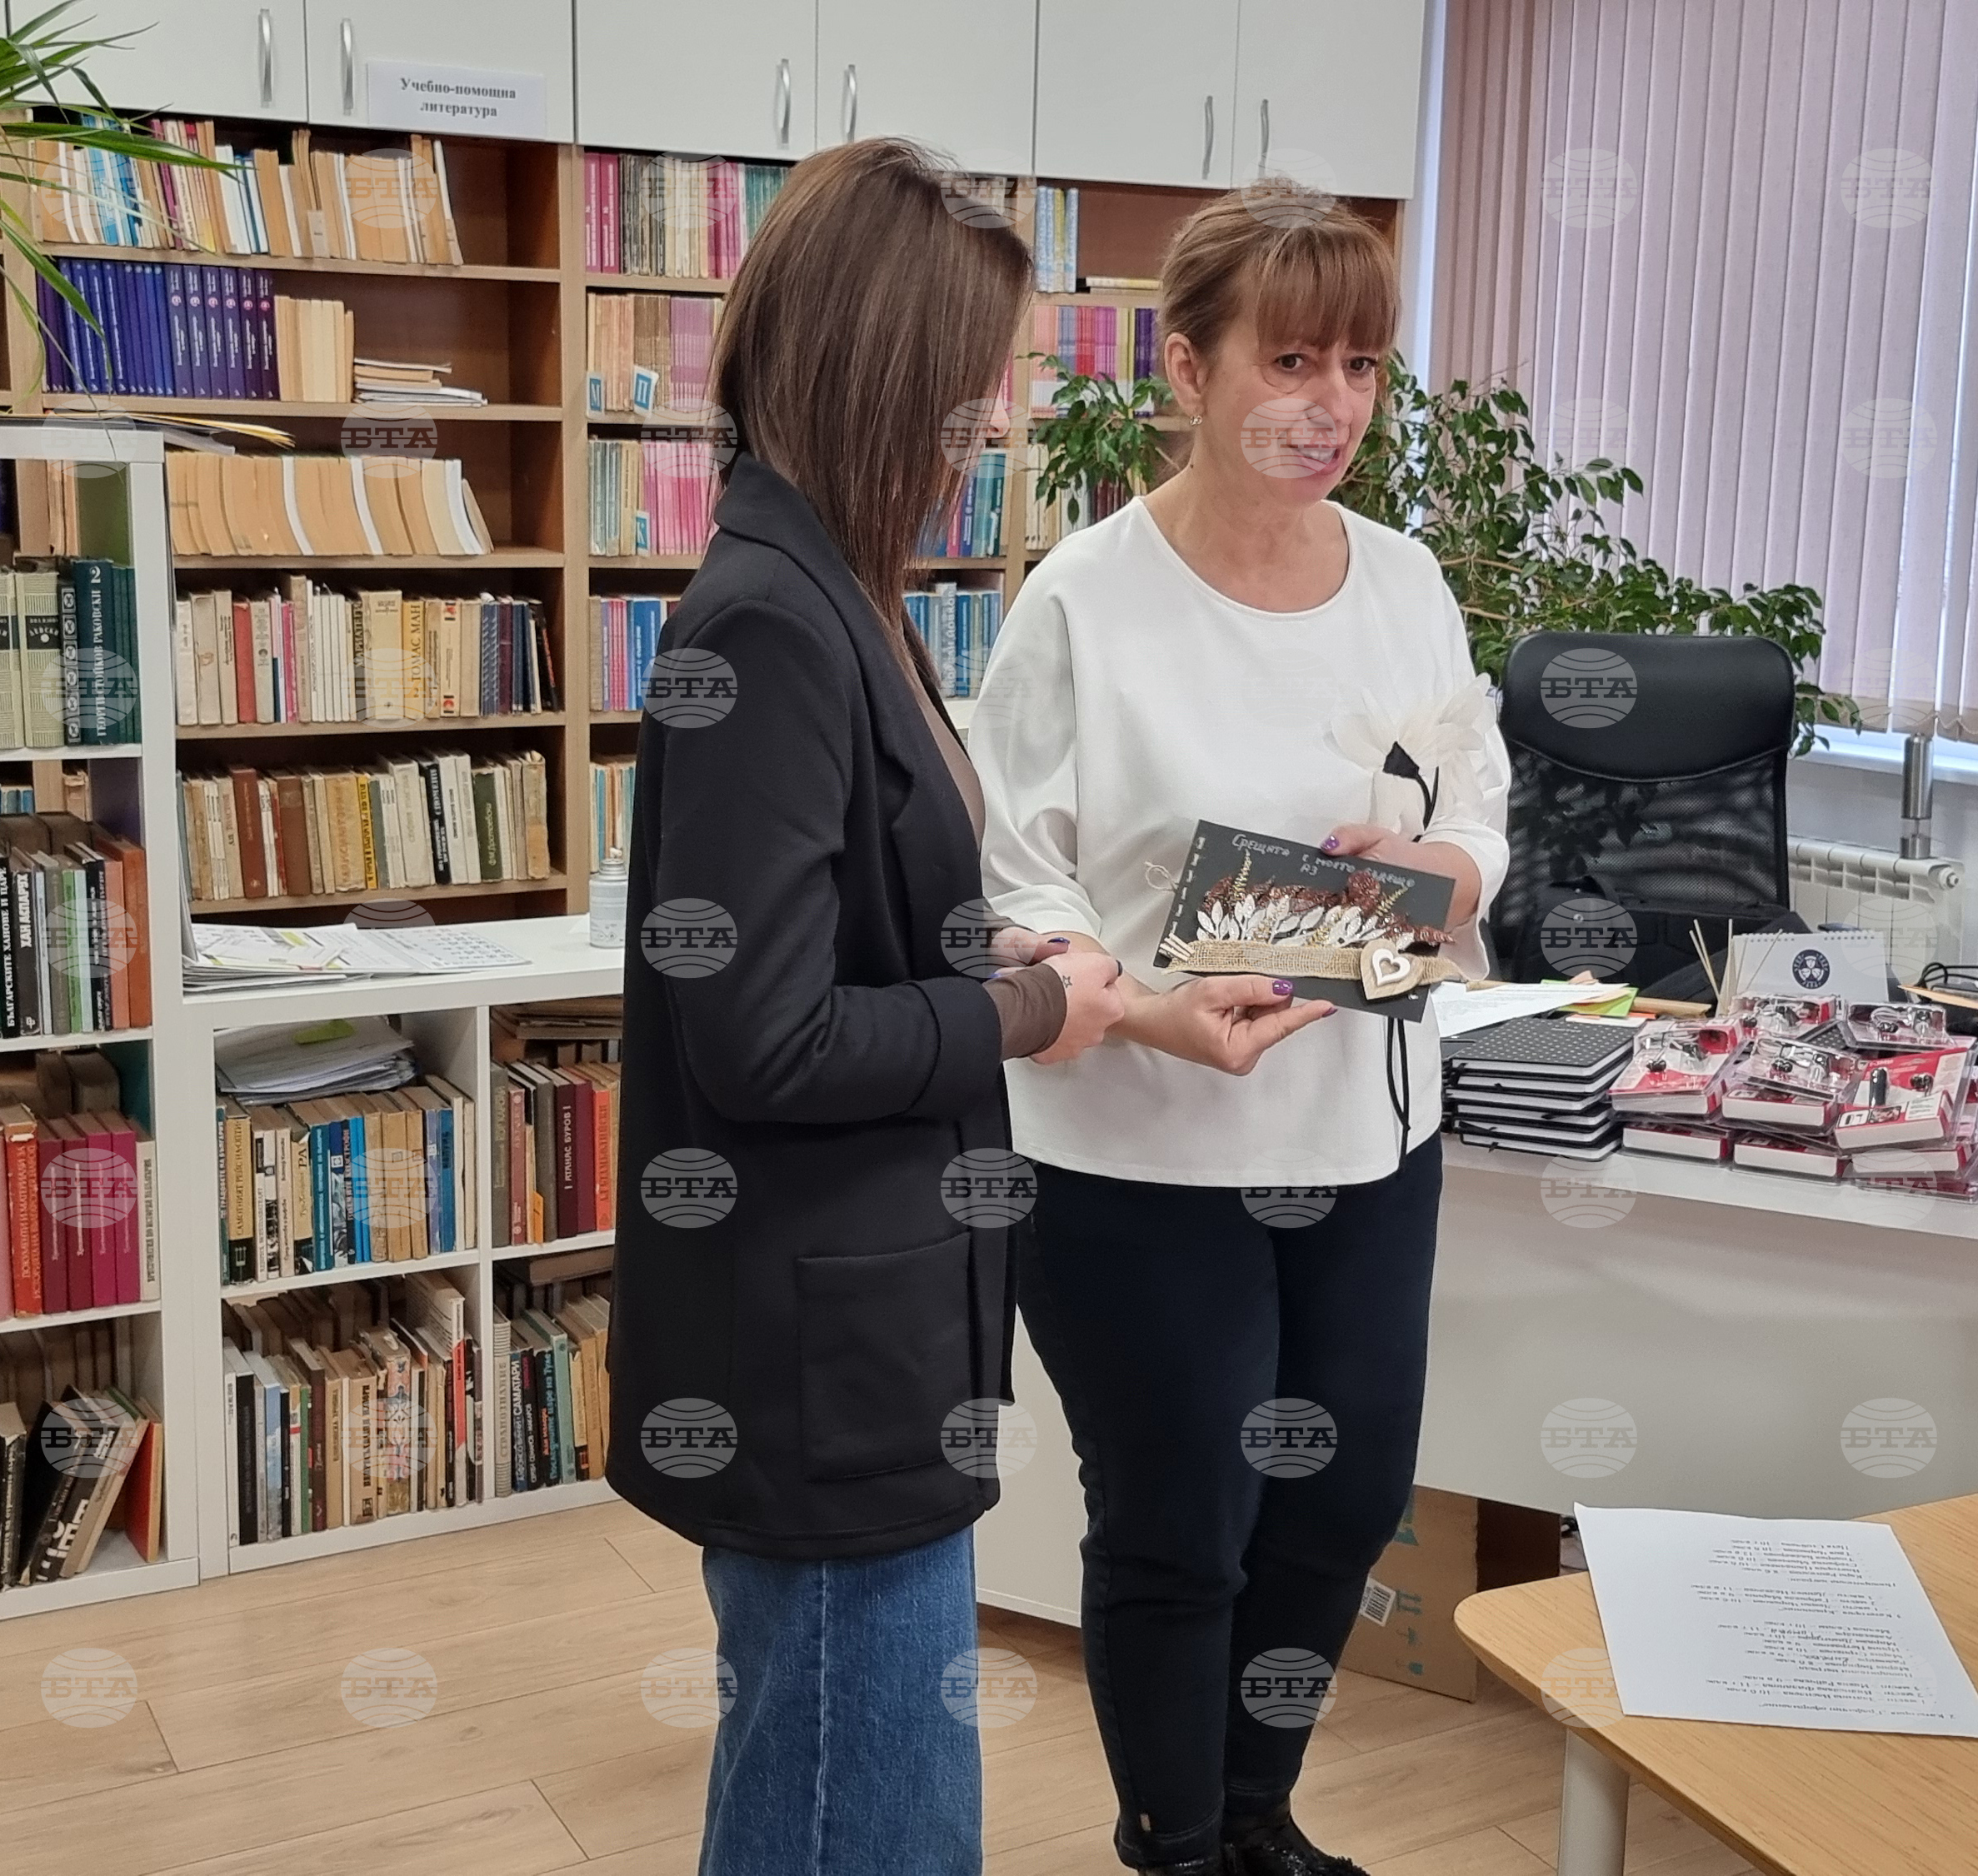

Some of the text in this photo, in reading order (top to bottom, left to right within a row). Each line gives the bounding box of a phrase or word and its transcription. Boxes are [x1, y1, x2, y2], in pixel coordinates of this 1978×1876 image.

[400, 77, 517, 100] Учебно-помощна
[419, 101, 498, 119] литература
[637, 379, 647, 404] П
[89, 566, 102, 584] 2
[411, 605, 420, 633] МАН
[91, 590, 107, 736] ГЕОРГИ СТОЙКОВ РАКОВСКИ
[411, 638, 421, 682] ТОМАС
[17, 873, 32, 948] ХАН АСПАРУХ
[2, 909, 11, 951] ХАНОВЕ
[3, 954, 15, 1026] БЪЛГАРСКИТЕ
[297, 1148, 307, 1170] РА
[512, 1360, 522, 1416] САМАТАРИ
